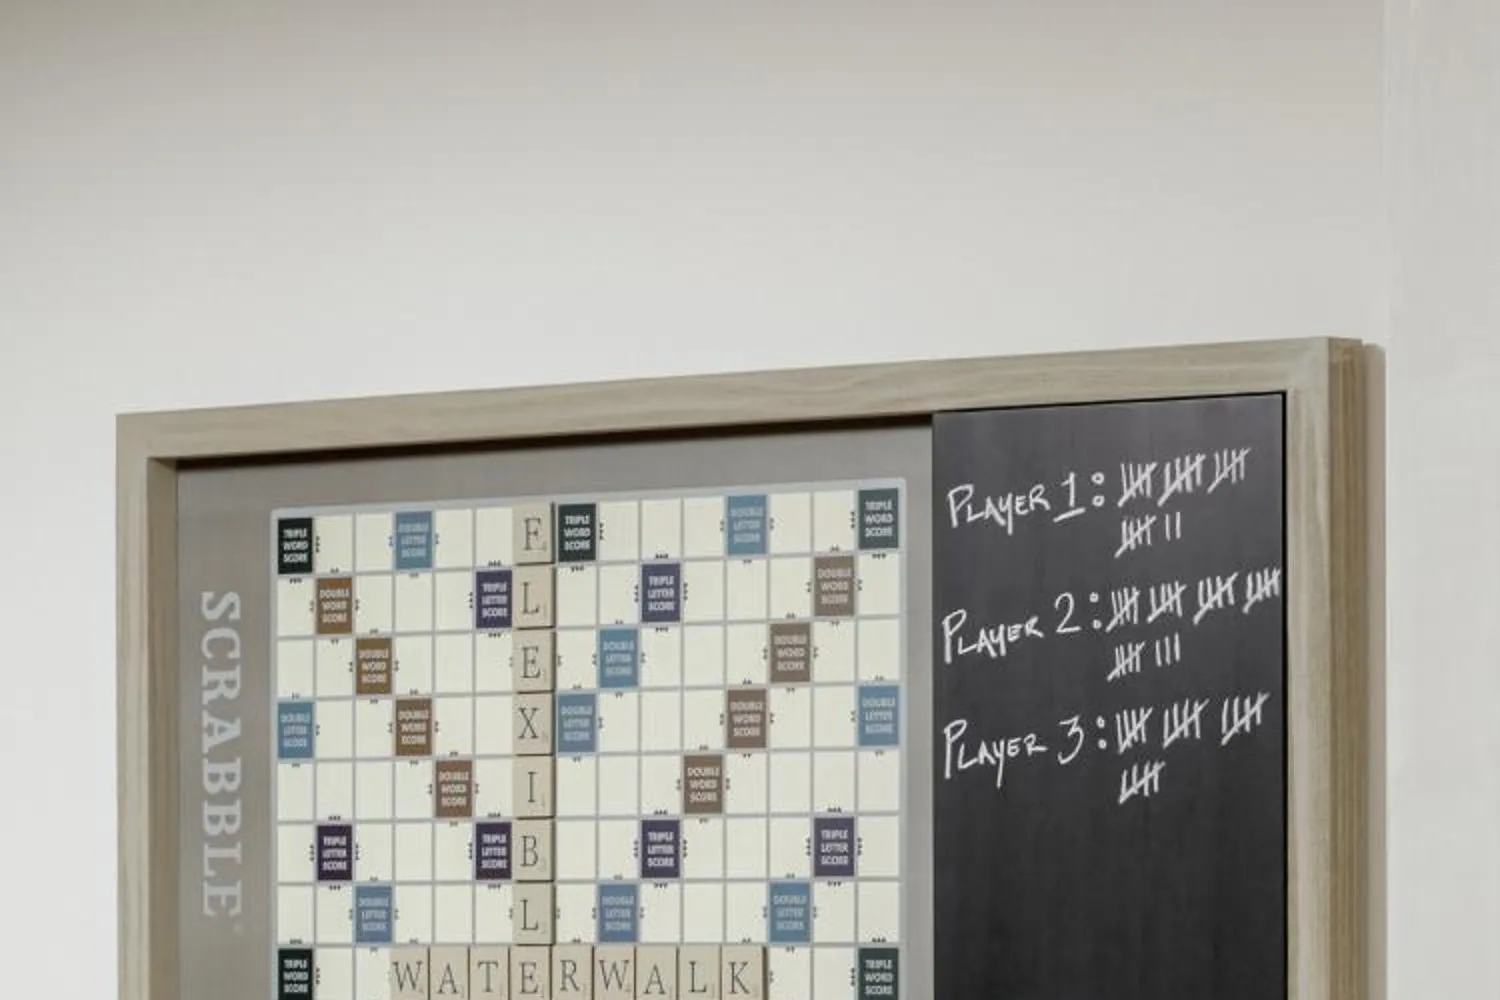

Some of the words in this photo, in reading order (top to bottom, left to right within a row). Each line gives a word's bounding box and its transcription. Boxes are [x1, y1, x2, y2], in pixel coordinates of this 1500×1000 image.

[947, 483, 1051, 536] PLAYER
[942, 608, 1045, 664] PLAYER
[200, 590, 242, 918] SCRABBLE
[943, 718, 1049, 790] PLAYER
[391, 957, 753, 996] WATERWALK
